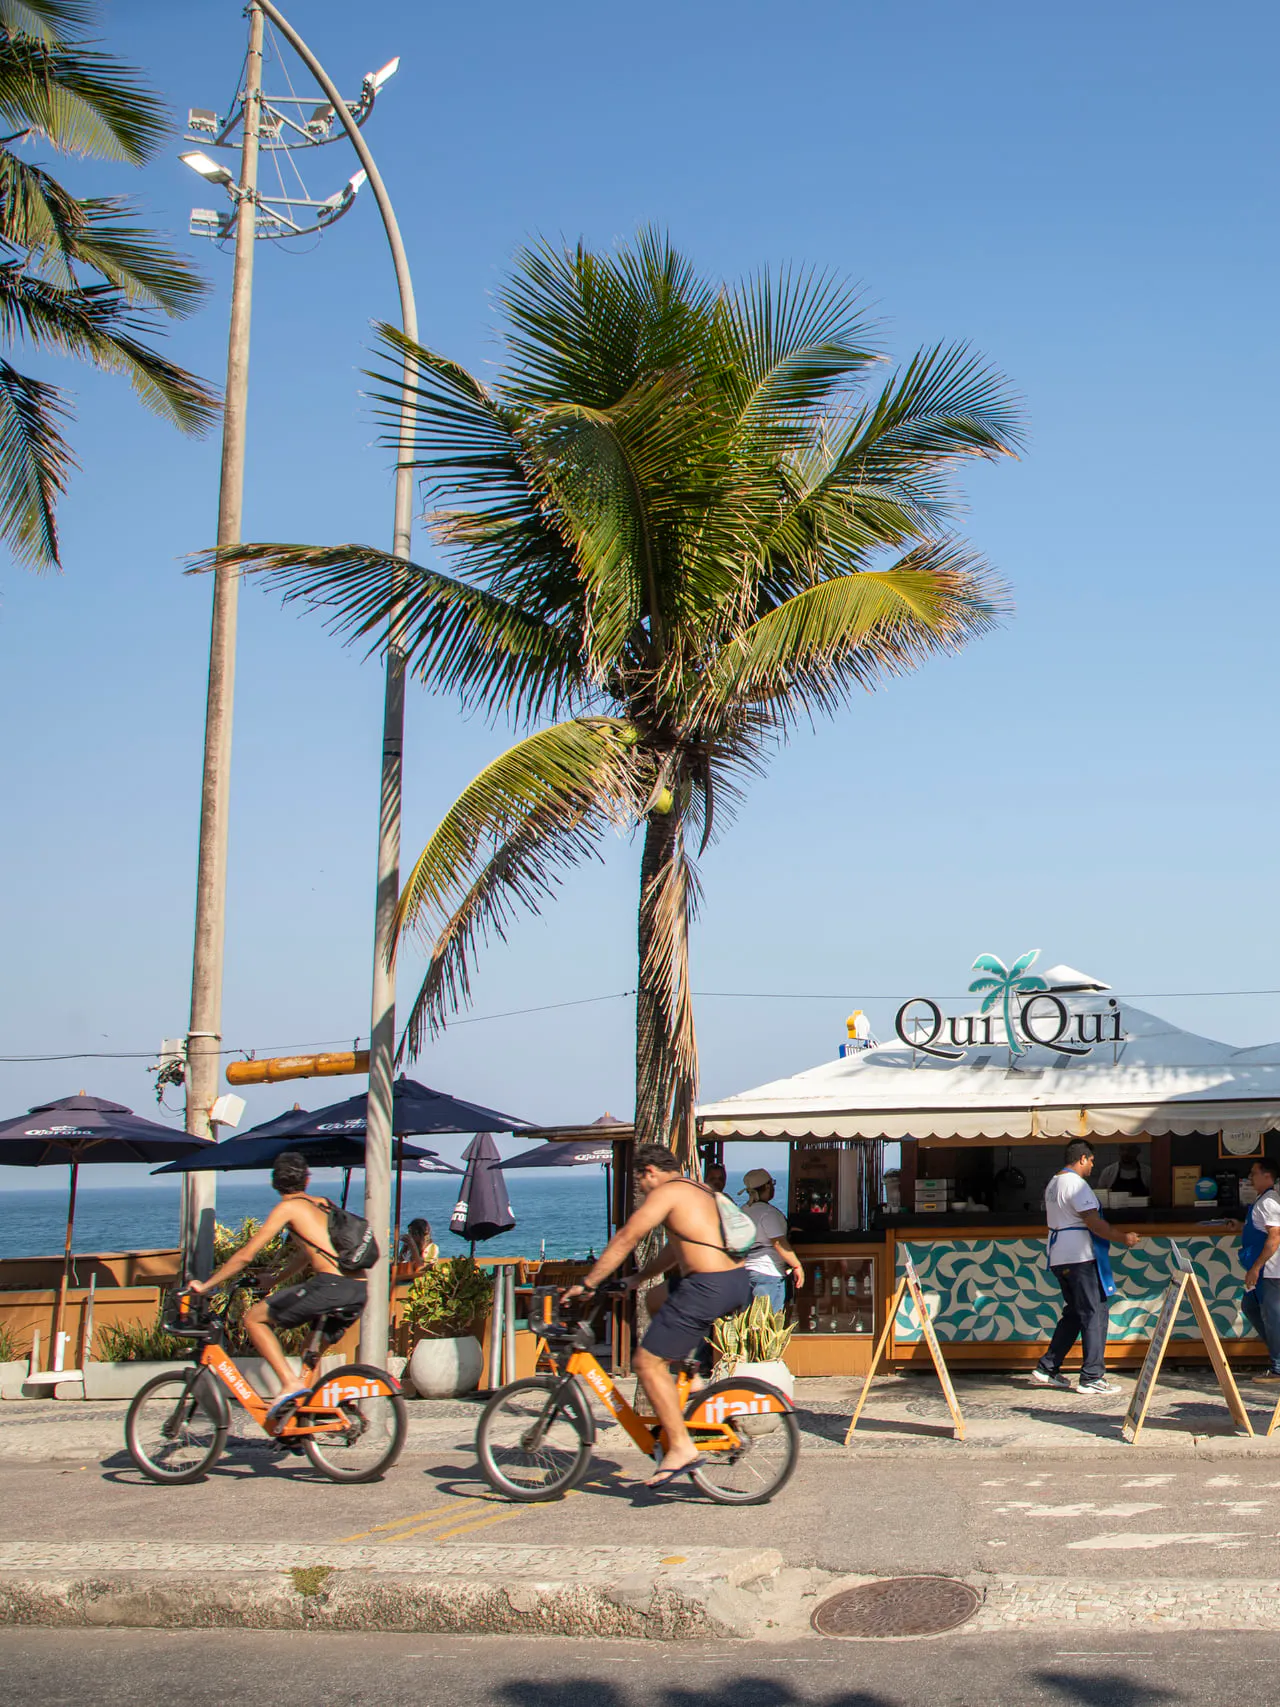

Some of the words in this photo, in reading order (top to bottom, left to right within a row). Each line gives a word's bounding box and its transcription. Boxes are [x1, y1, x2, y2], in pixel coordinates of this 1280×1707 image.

[895, 998, 996, 1060] Qui
[1020, 994, 1125, 1055] Qui
[317, 1122, 368, 1131] Coron
[218, 1361, 237, 1383] bike
[586, 1369, 607, 1393] bike
